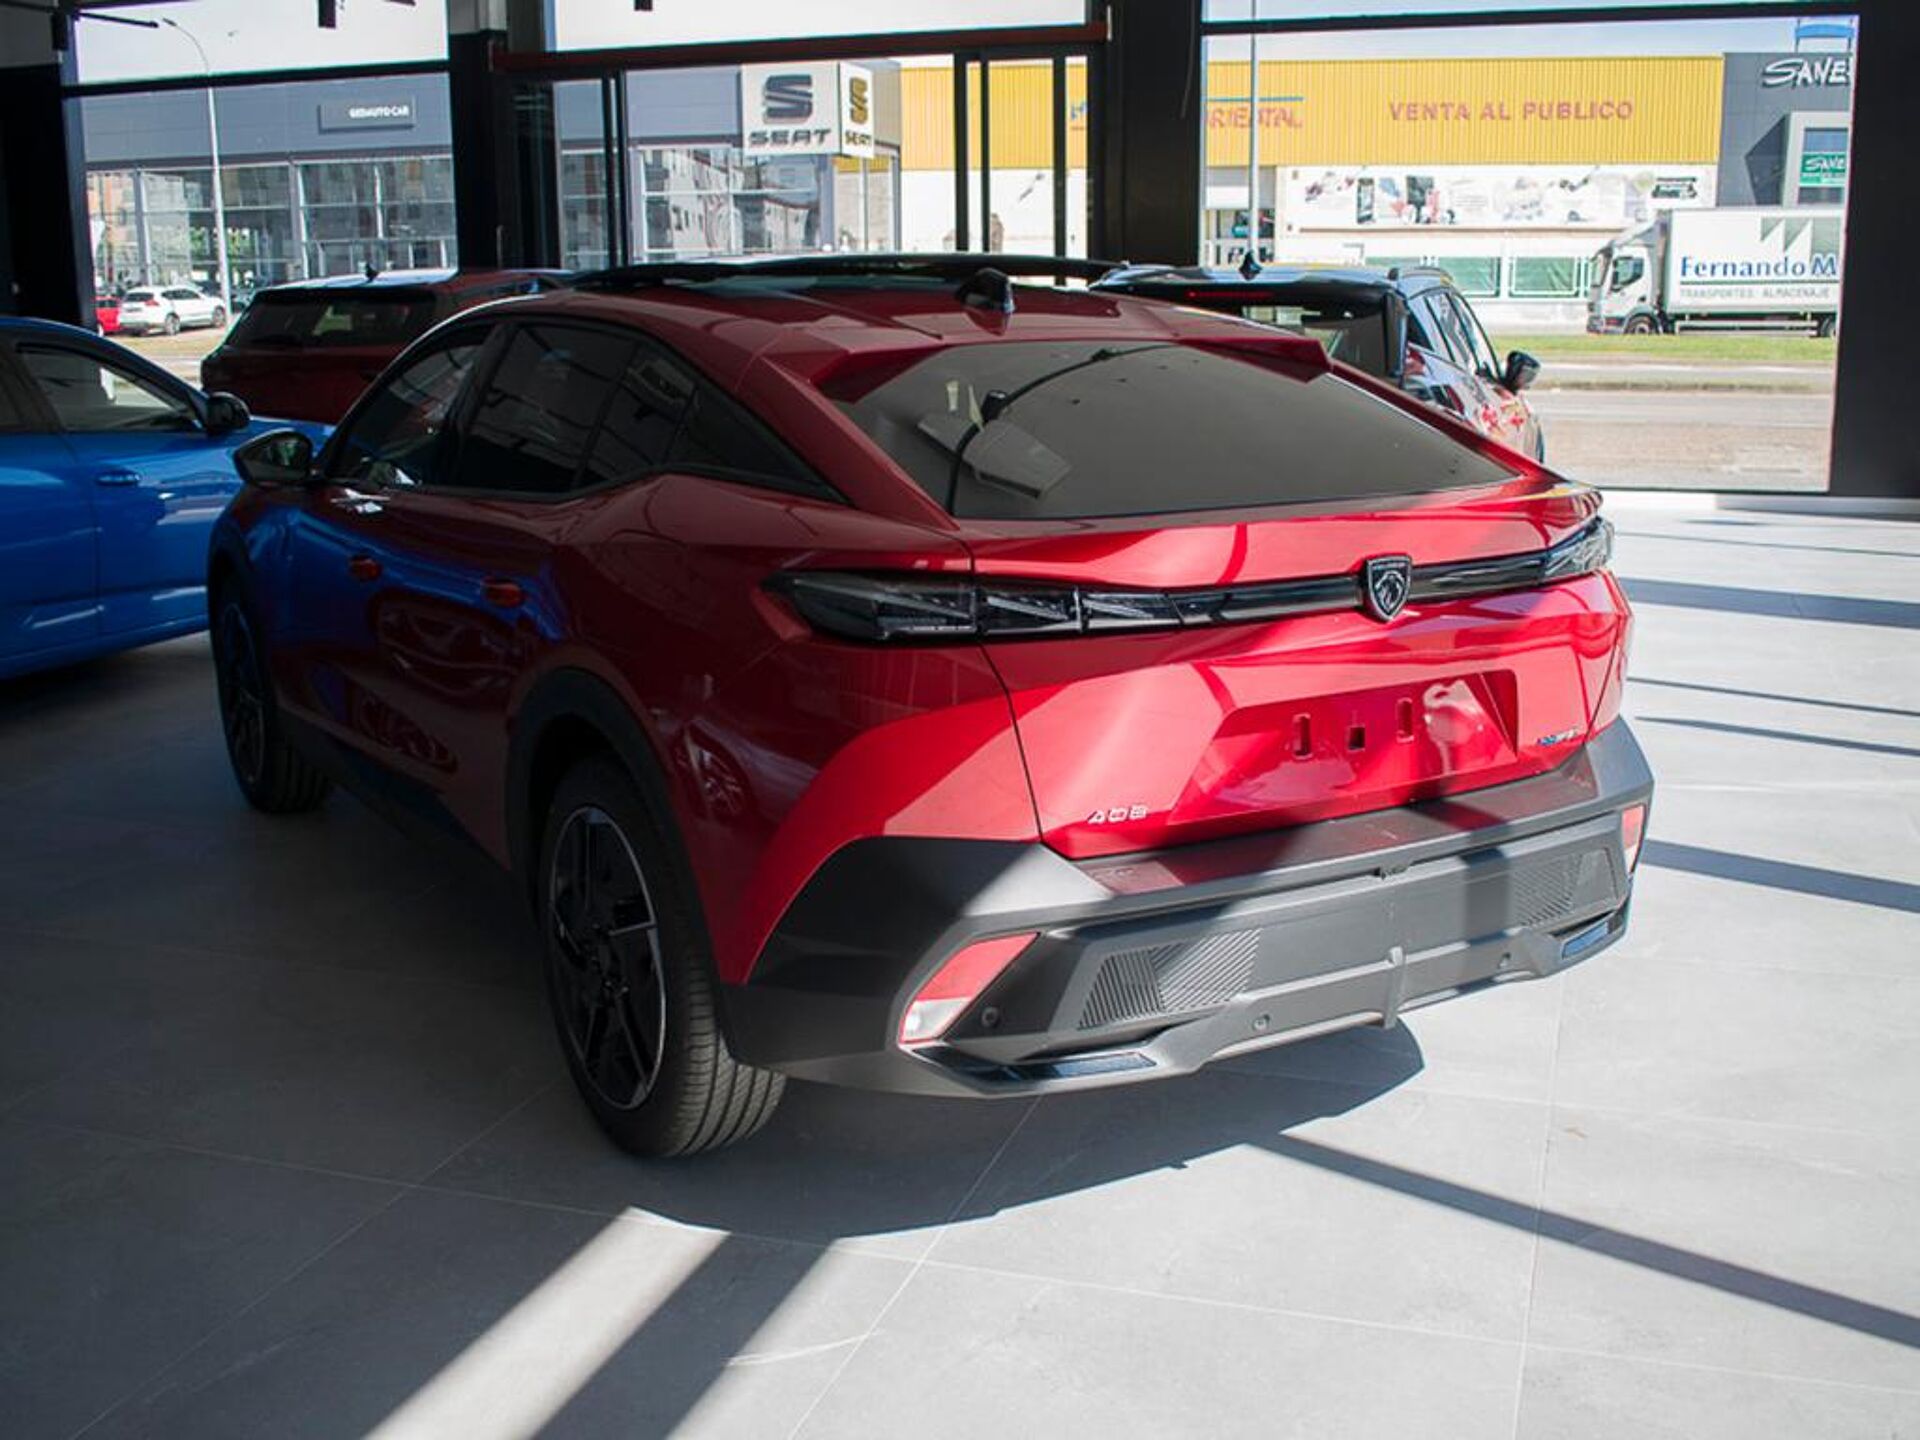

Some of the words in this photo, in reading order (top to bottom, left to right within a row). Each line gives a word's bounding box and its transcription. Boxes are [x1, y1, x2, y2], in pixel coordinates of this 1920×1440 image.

[1763, 56, 1852, 86] SANE
[1389, 101, 1471, 121] VENTA
[1481, 101, 1511, 121] AL
[1522, 100, 1634, 121] PUBLICO
[749, 128, 831, 146] SEAT
[1680, 255, 1806, 277] Fernando
[1087, 804, 1147, 825] 408
